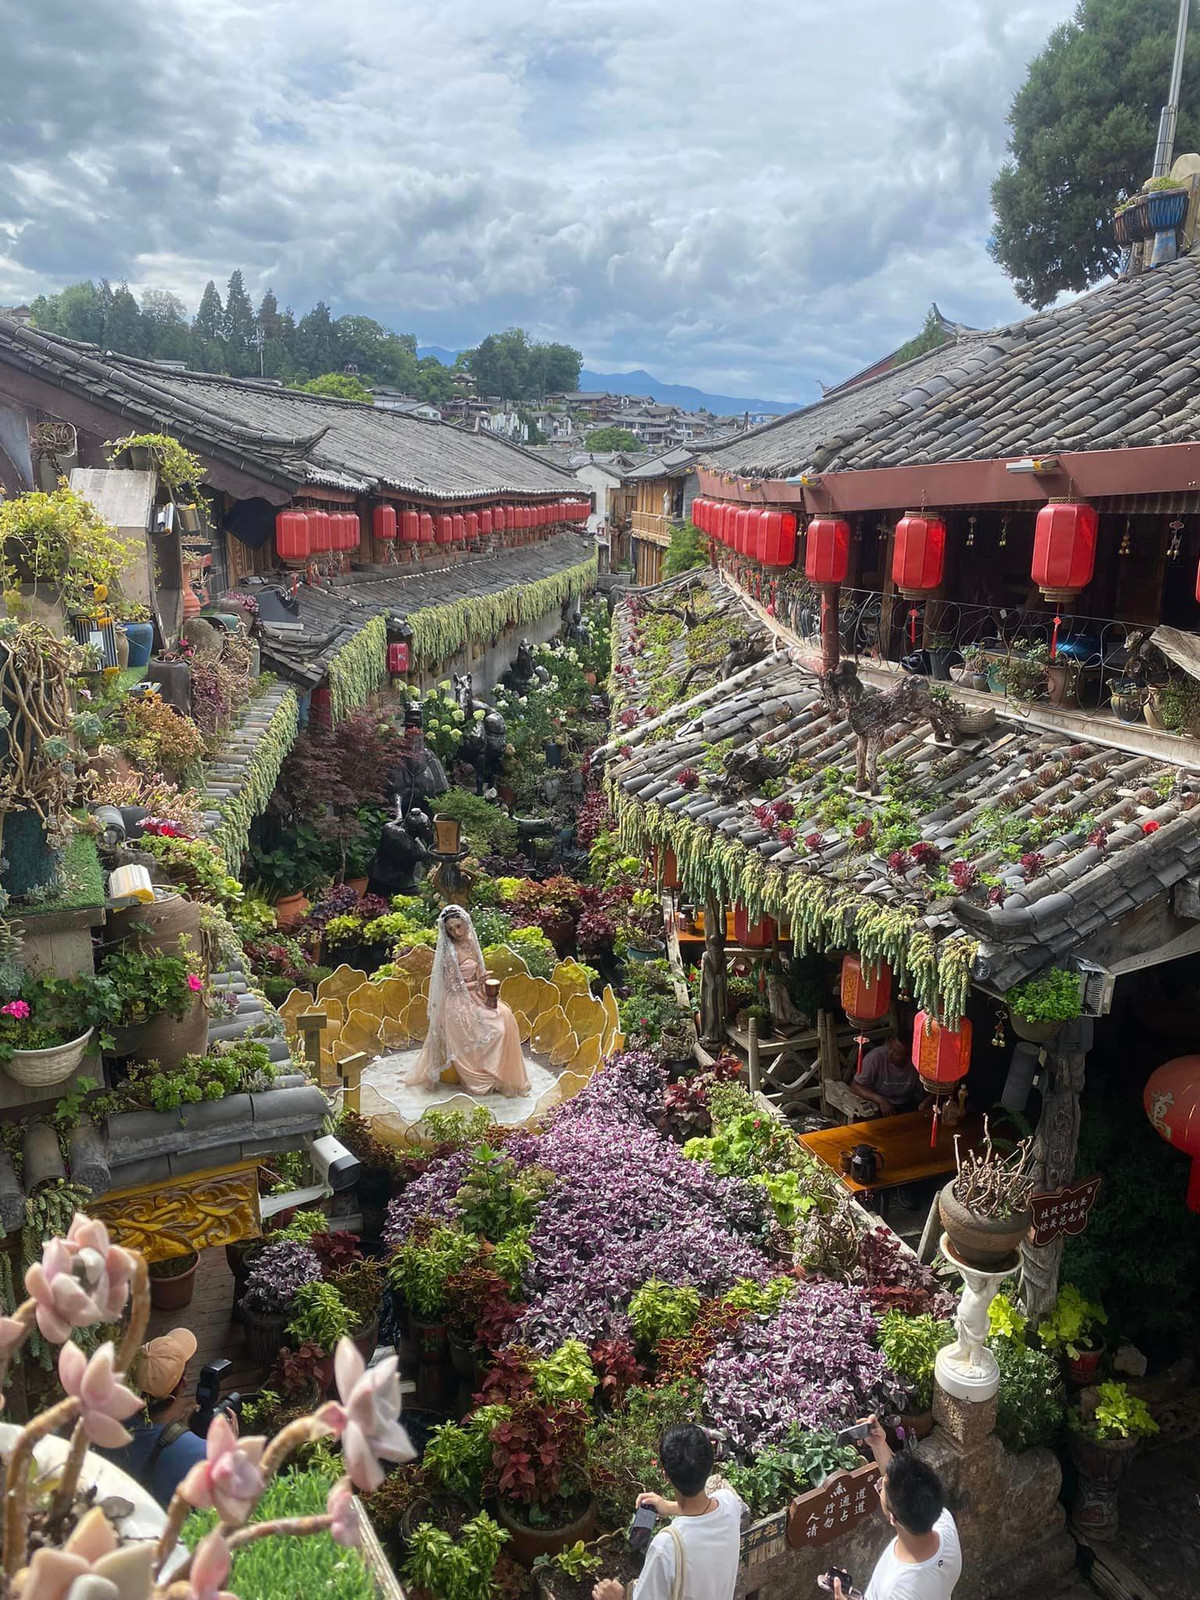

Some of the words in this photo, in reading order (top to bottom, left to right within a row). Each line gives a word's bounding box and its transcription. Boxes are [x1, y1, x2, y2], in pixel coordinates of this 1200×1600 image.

[806, 1487, 867, 1524] 人行通道
[806, 1501, 866, 1538] 请勿占道
